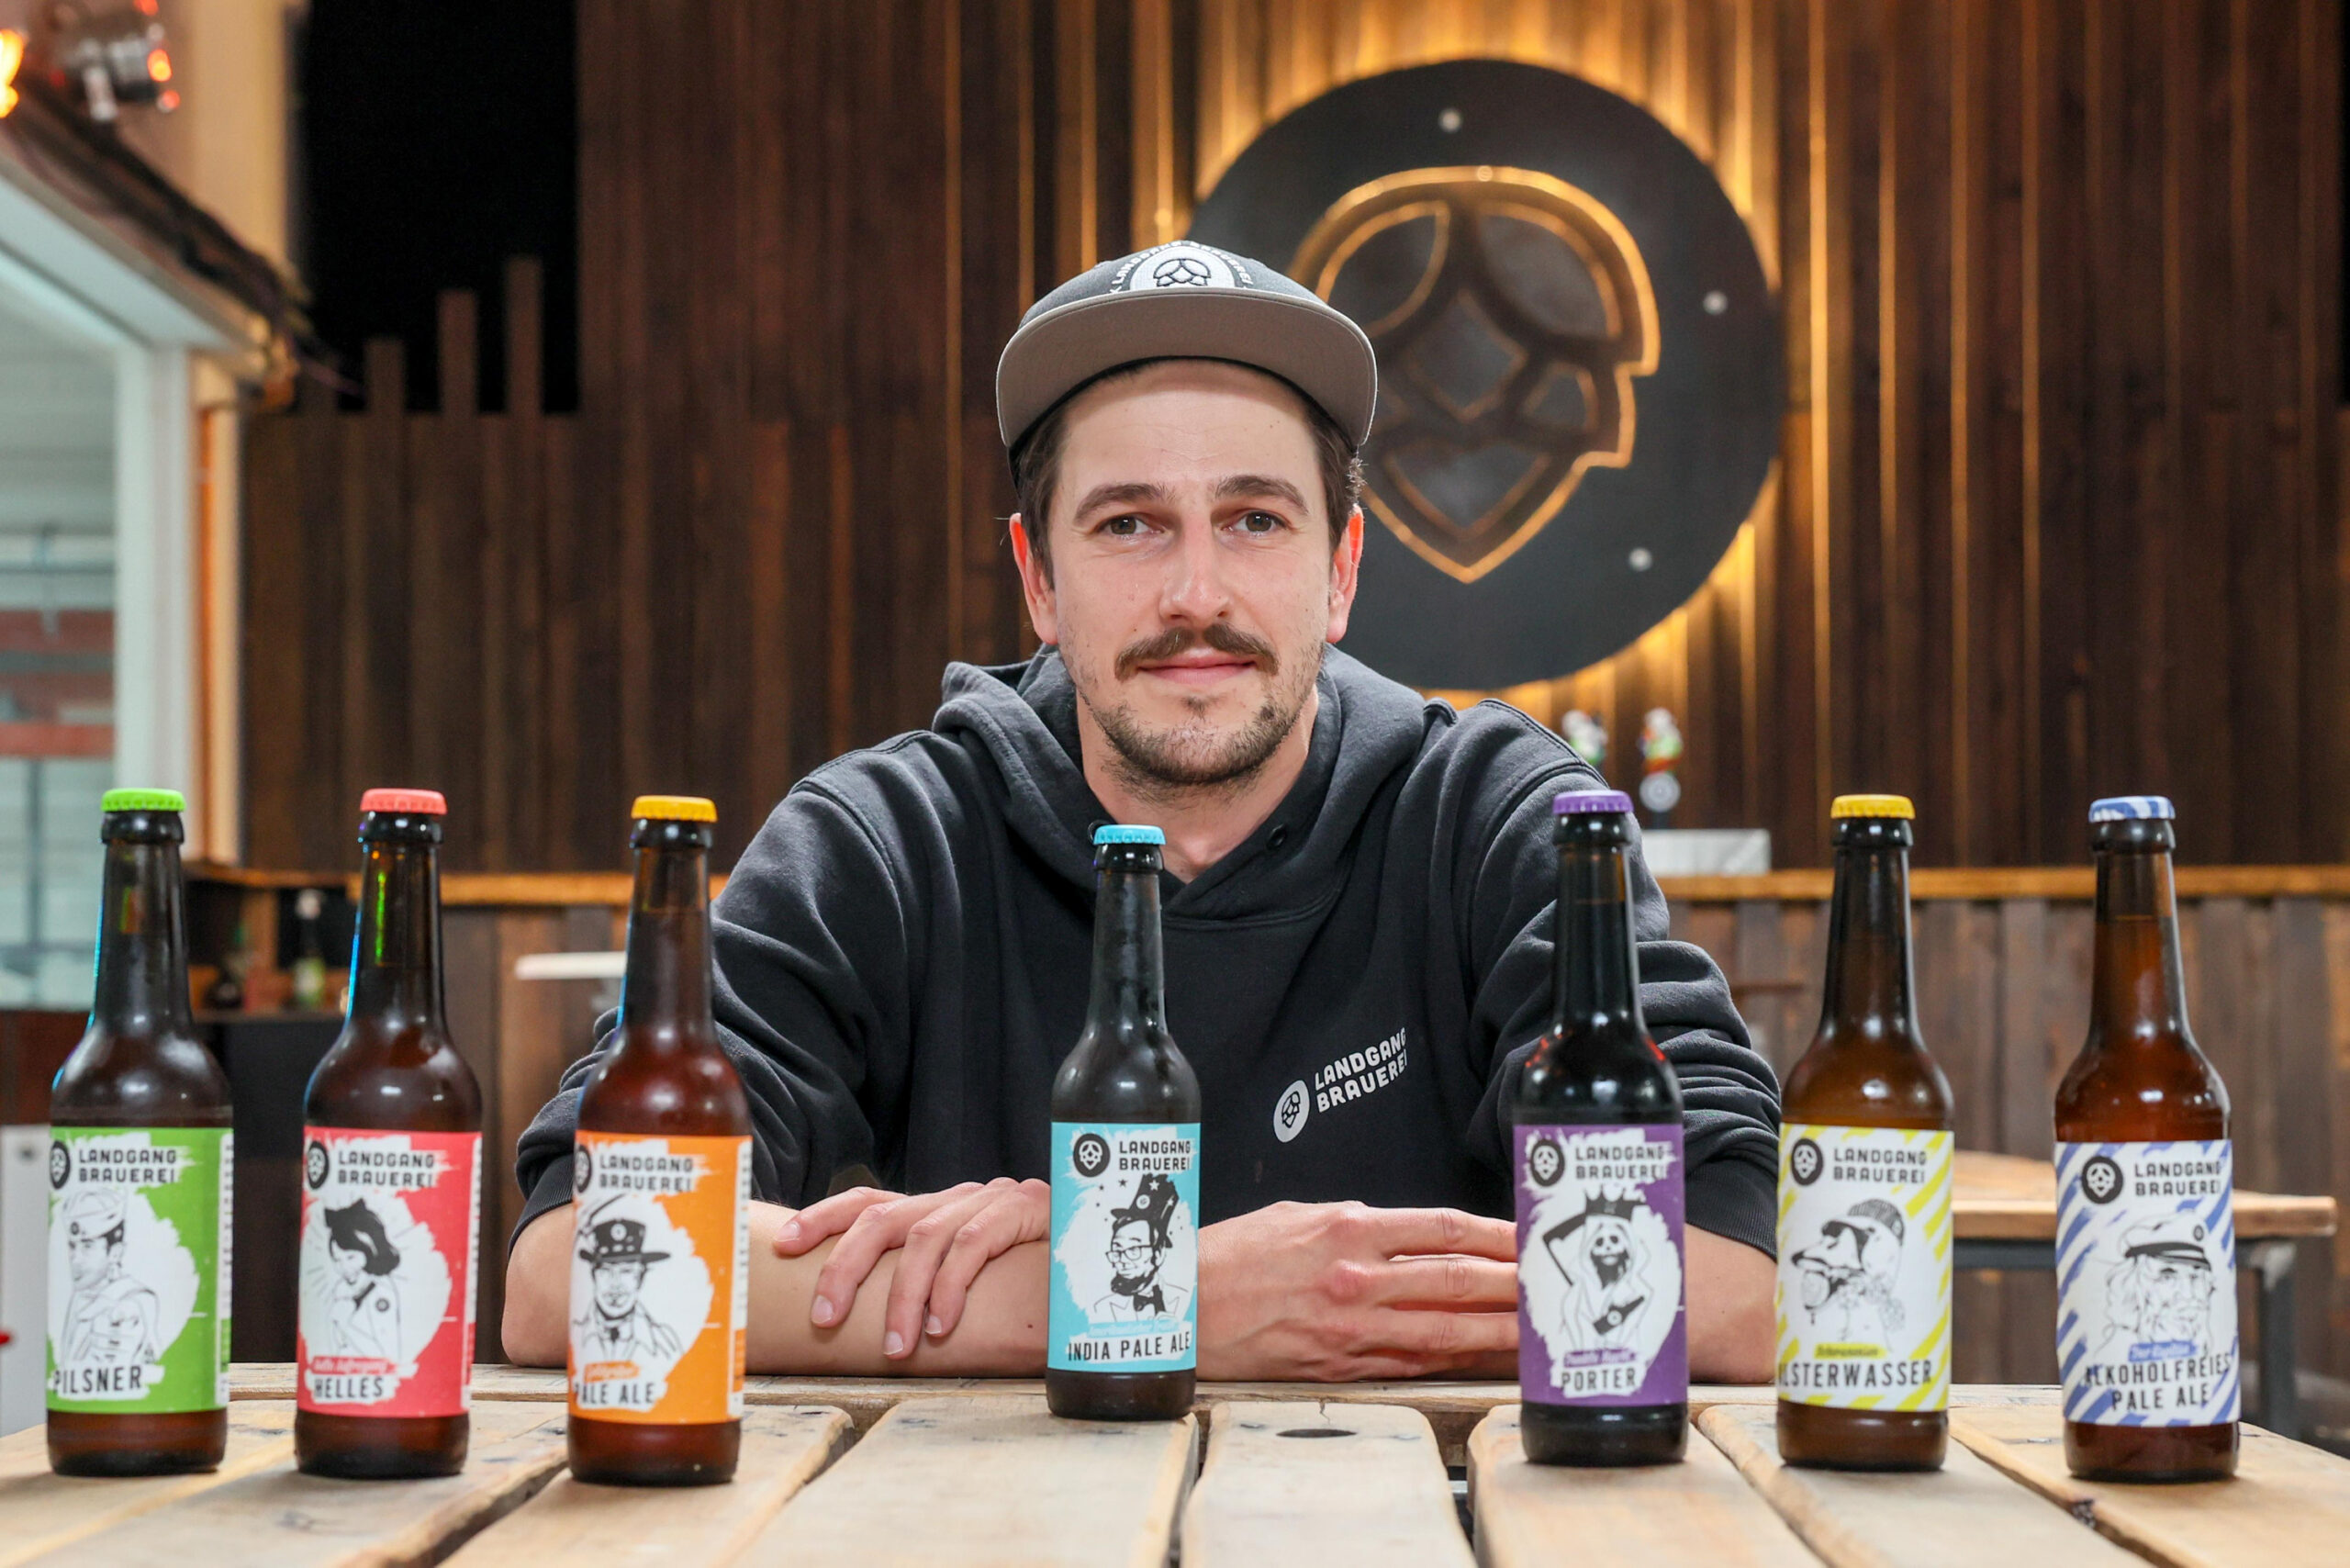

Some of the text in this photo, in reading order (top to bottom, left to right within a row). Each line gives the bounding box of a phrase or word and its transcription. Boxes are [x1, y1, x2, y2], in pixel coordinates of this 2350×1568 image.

[1315, 1026, 1406, 1091] LANDGANG
[1316, 1048, 1408, 1113] BRAUEREI
[79, 1149, 177, 1164] LANDGANG
[1119, 1140, 1191, 1155] LANDGANG
[1575, 1146, 1664, 1161] LANDGANG
[1834, 1148, 1927, 1166] LANDGANG
[338, 1150, 435, 1168] LANDGANG
[599, 1154, 694, 1173] LANDGANG
[1119, 1157, 1190, 1171] BRAUEREI
[79, 1168, 175, 1183] BRAUEREI
[338, 1170, 433, 1187] BRAUEREI
[1833, 1165, 1926, 1184] BRAUEREI
[2134, 1160, 2221, 1178] LANDGANG
[599, 1174, 692, 1193] BRAUEREI
[1068, 1330, 1191, 1361] INDIA PALE ALE
[53, 1365, 142, 1394] PILSNER
[314, 1375, 384, 1399] HELLES
[1561, 1367, 1636, 1393] PORTER
[619, 1382, 655, 1405] ALE
[2112, 1382, 2210, 1411] PALE ALE
